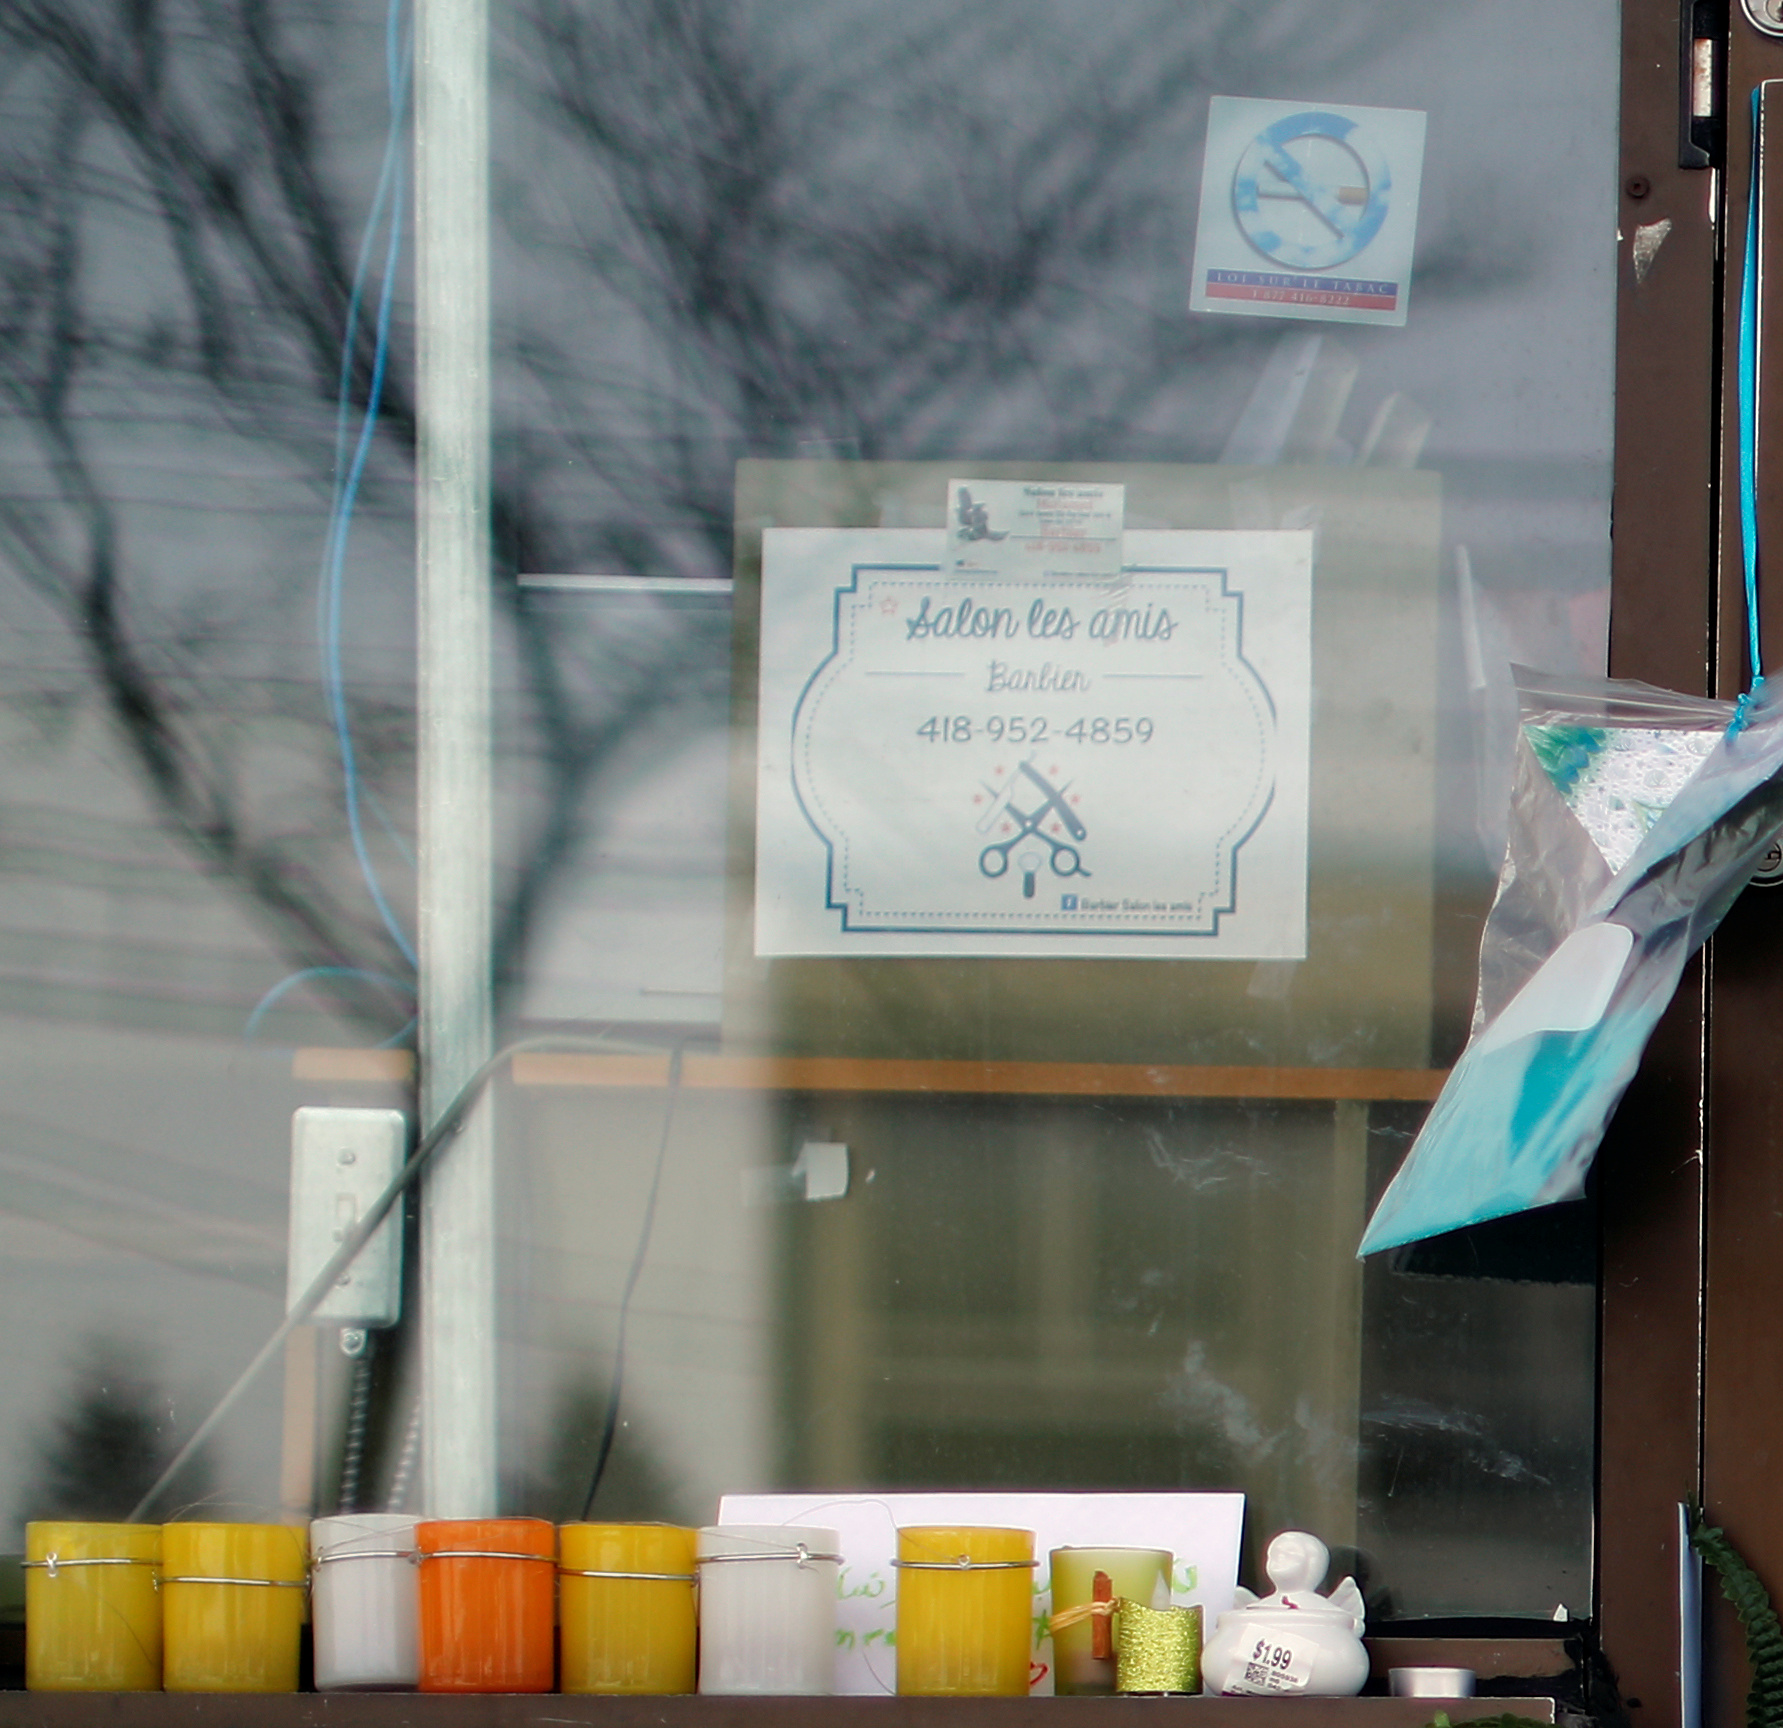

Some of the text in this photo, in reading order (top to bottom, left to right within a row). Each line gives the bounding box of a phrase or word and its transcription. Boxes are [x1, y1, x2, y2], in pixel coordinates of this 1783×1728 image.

[1333, 281, 1389, 295] TABAC
[906, 596, 1179, 642] Salon les amis
[986, 659, 1091, 693] Barbier
[915, 715, 1154, 744] 418-952-4859
[1252, 1638, 1293, 1670] $1.99
